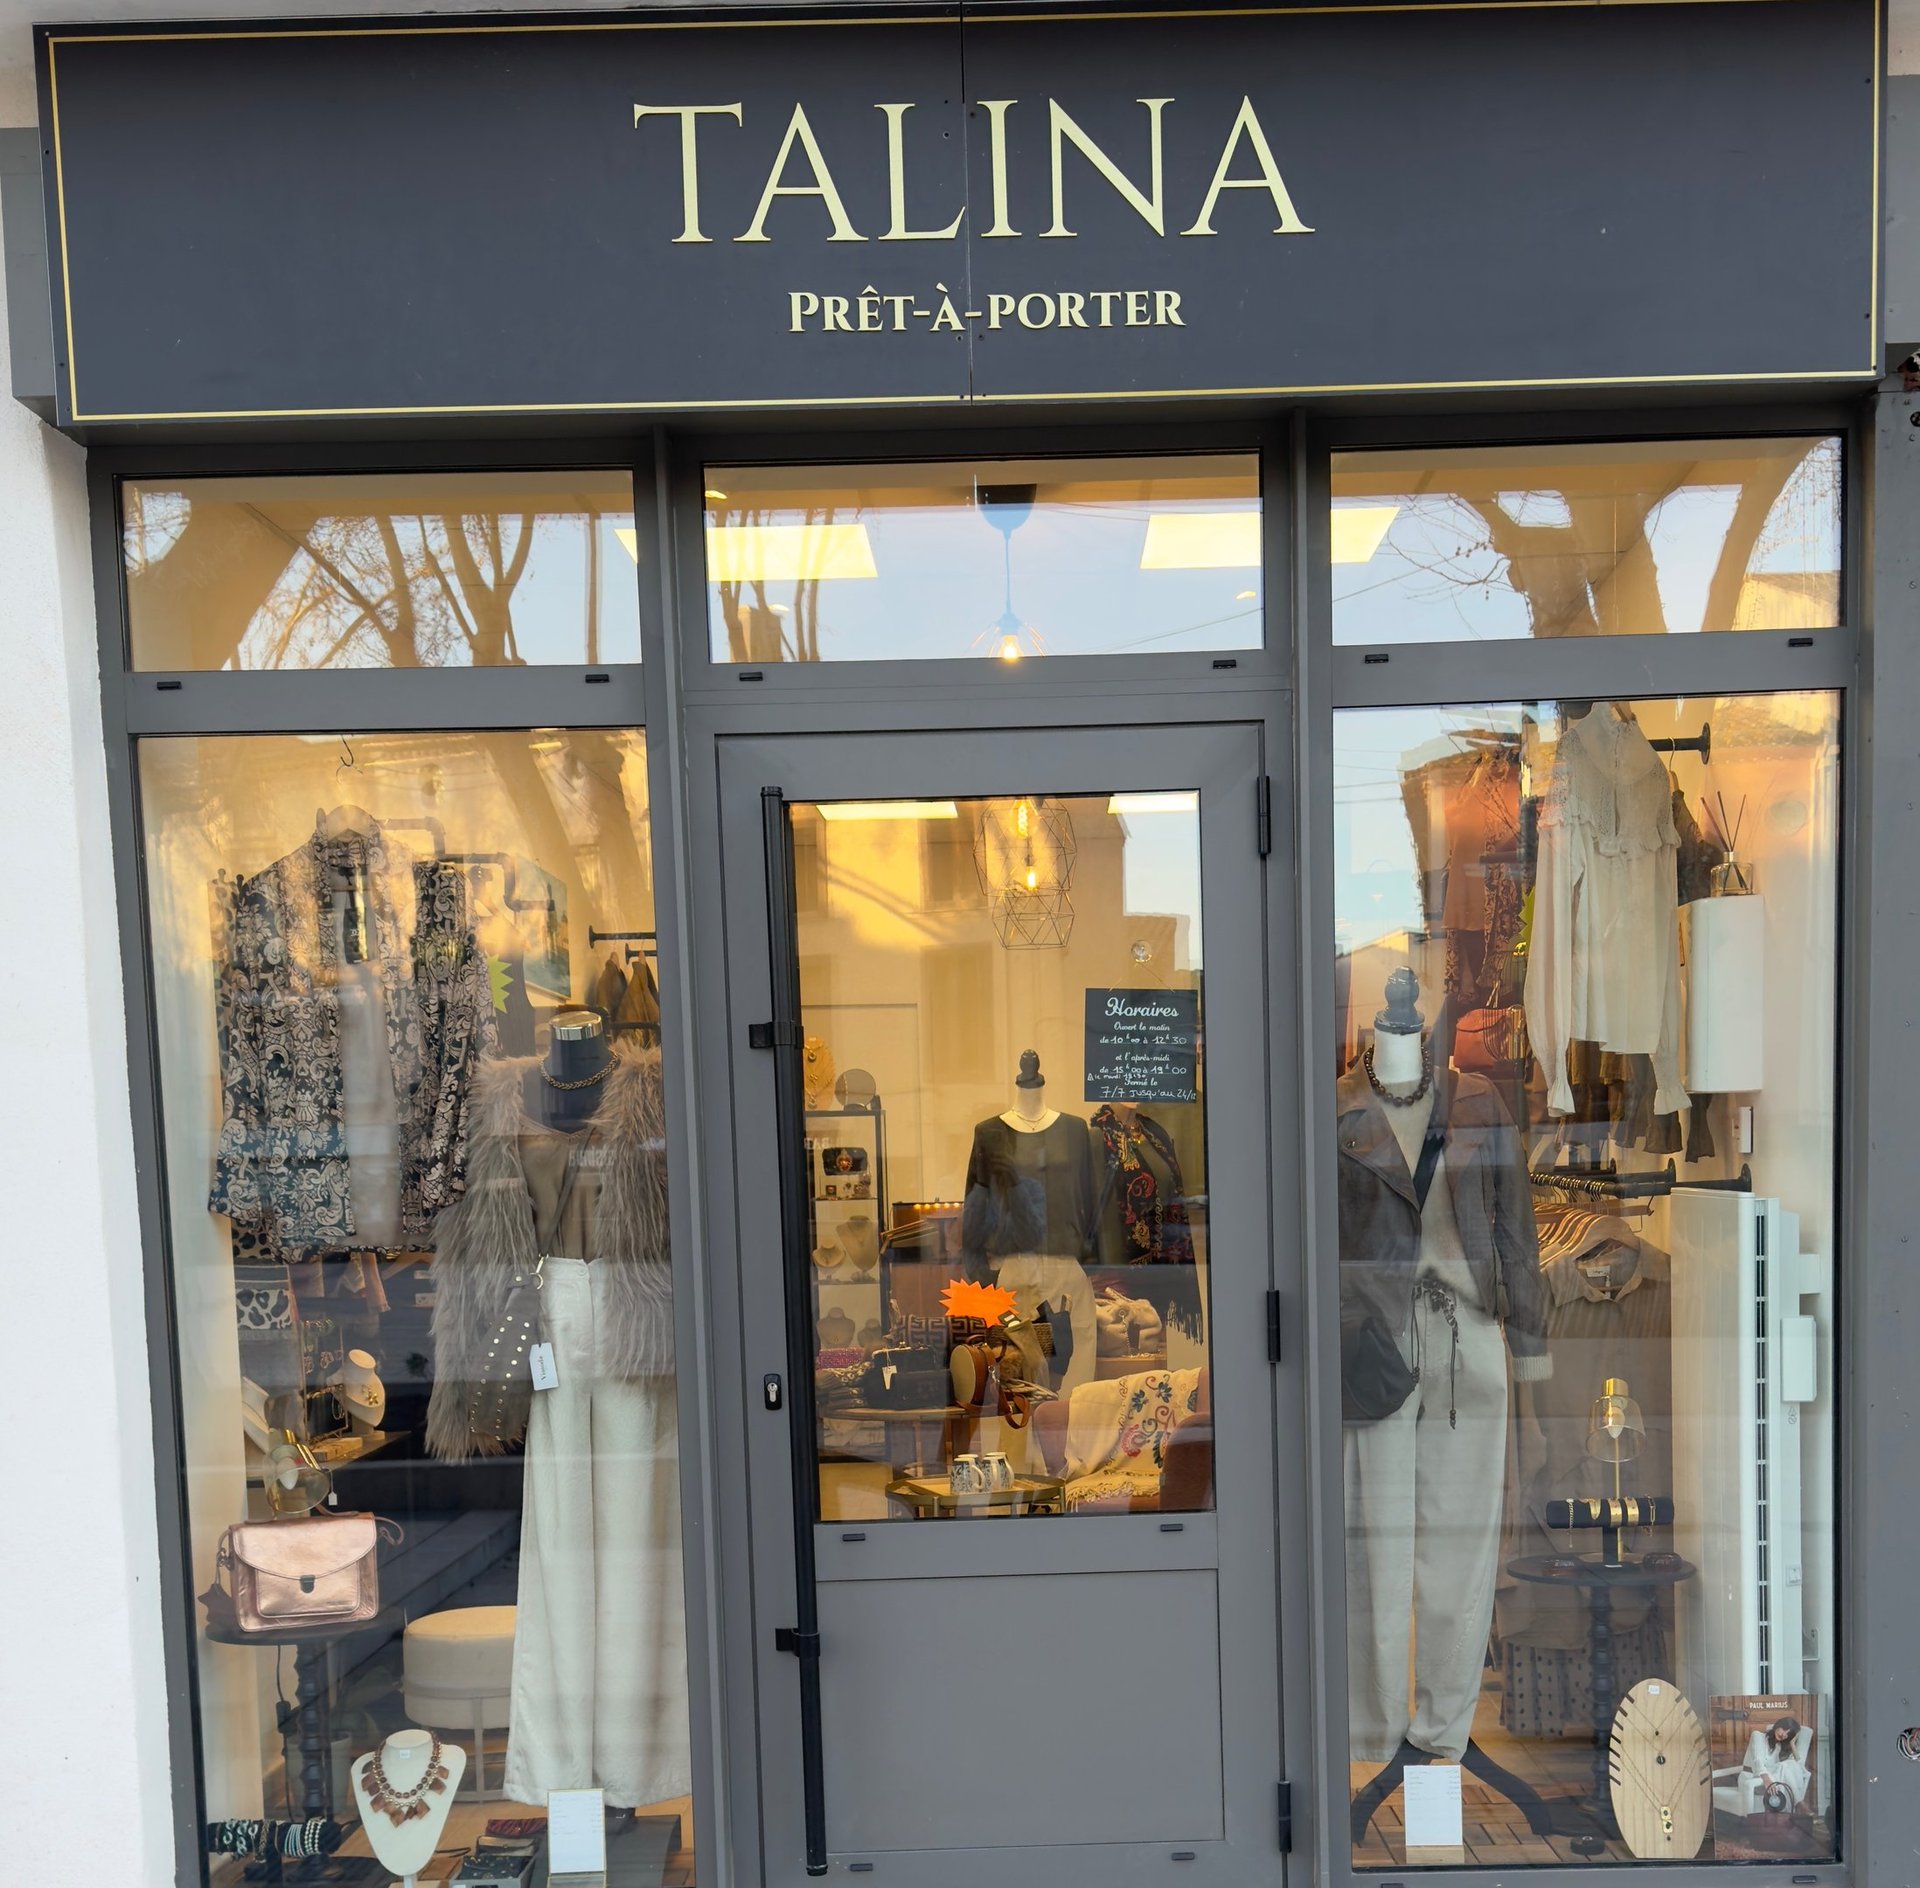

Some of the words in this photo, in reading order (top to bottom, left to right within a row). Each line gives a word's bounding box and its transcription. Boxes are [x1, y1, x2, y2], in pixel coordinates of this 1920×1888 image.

[633, 95, 1316, 245] TALINA
[788, 283, 1187, 333] PRÊT-À-PORTER
[1105, 997, 1179, 1017] Horaires
[1113, 1021, 1137, 1031] Ouvert
[1139, 1022, 1147, 1031] le
[1100, 1036, 1110, 1044] de
[1124, 1078, 1148, 1086] Fermé
[1150, 1077, 1158, 1086] le
[1101, 1085, 1125, 1098] 7/7
[1129, 1088, 1176, 1100] jusqu'au
[1766, 1701, 1788, 1709] MARIUS
